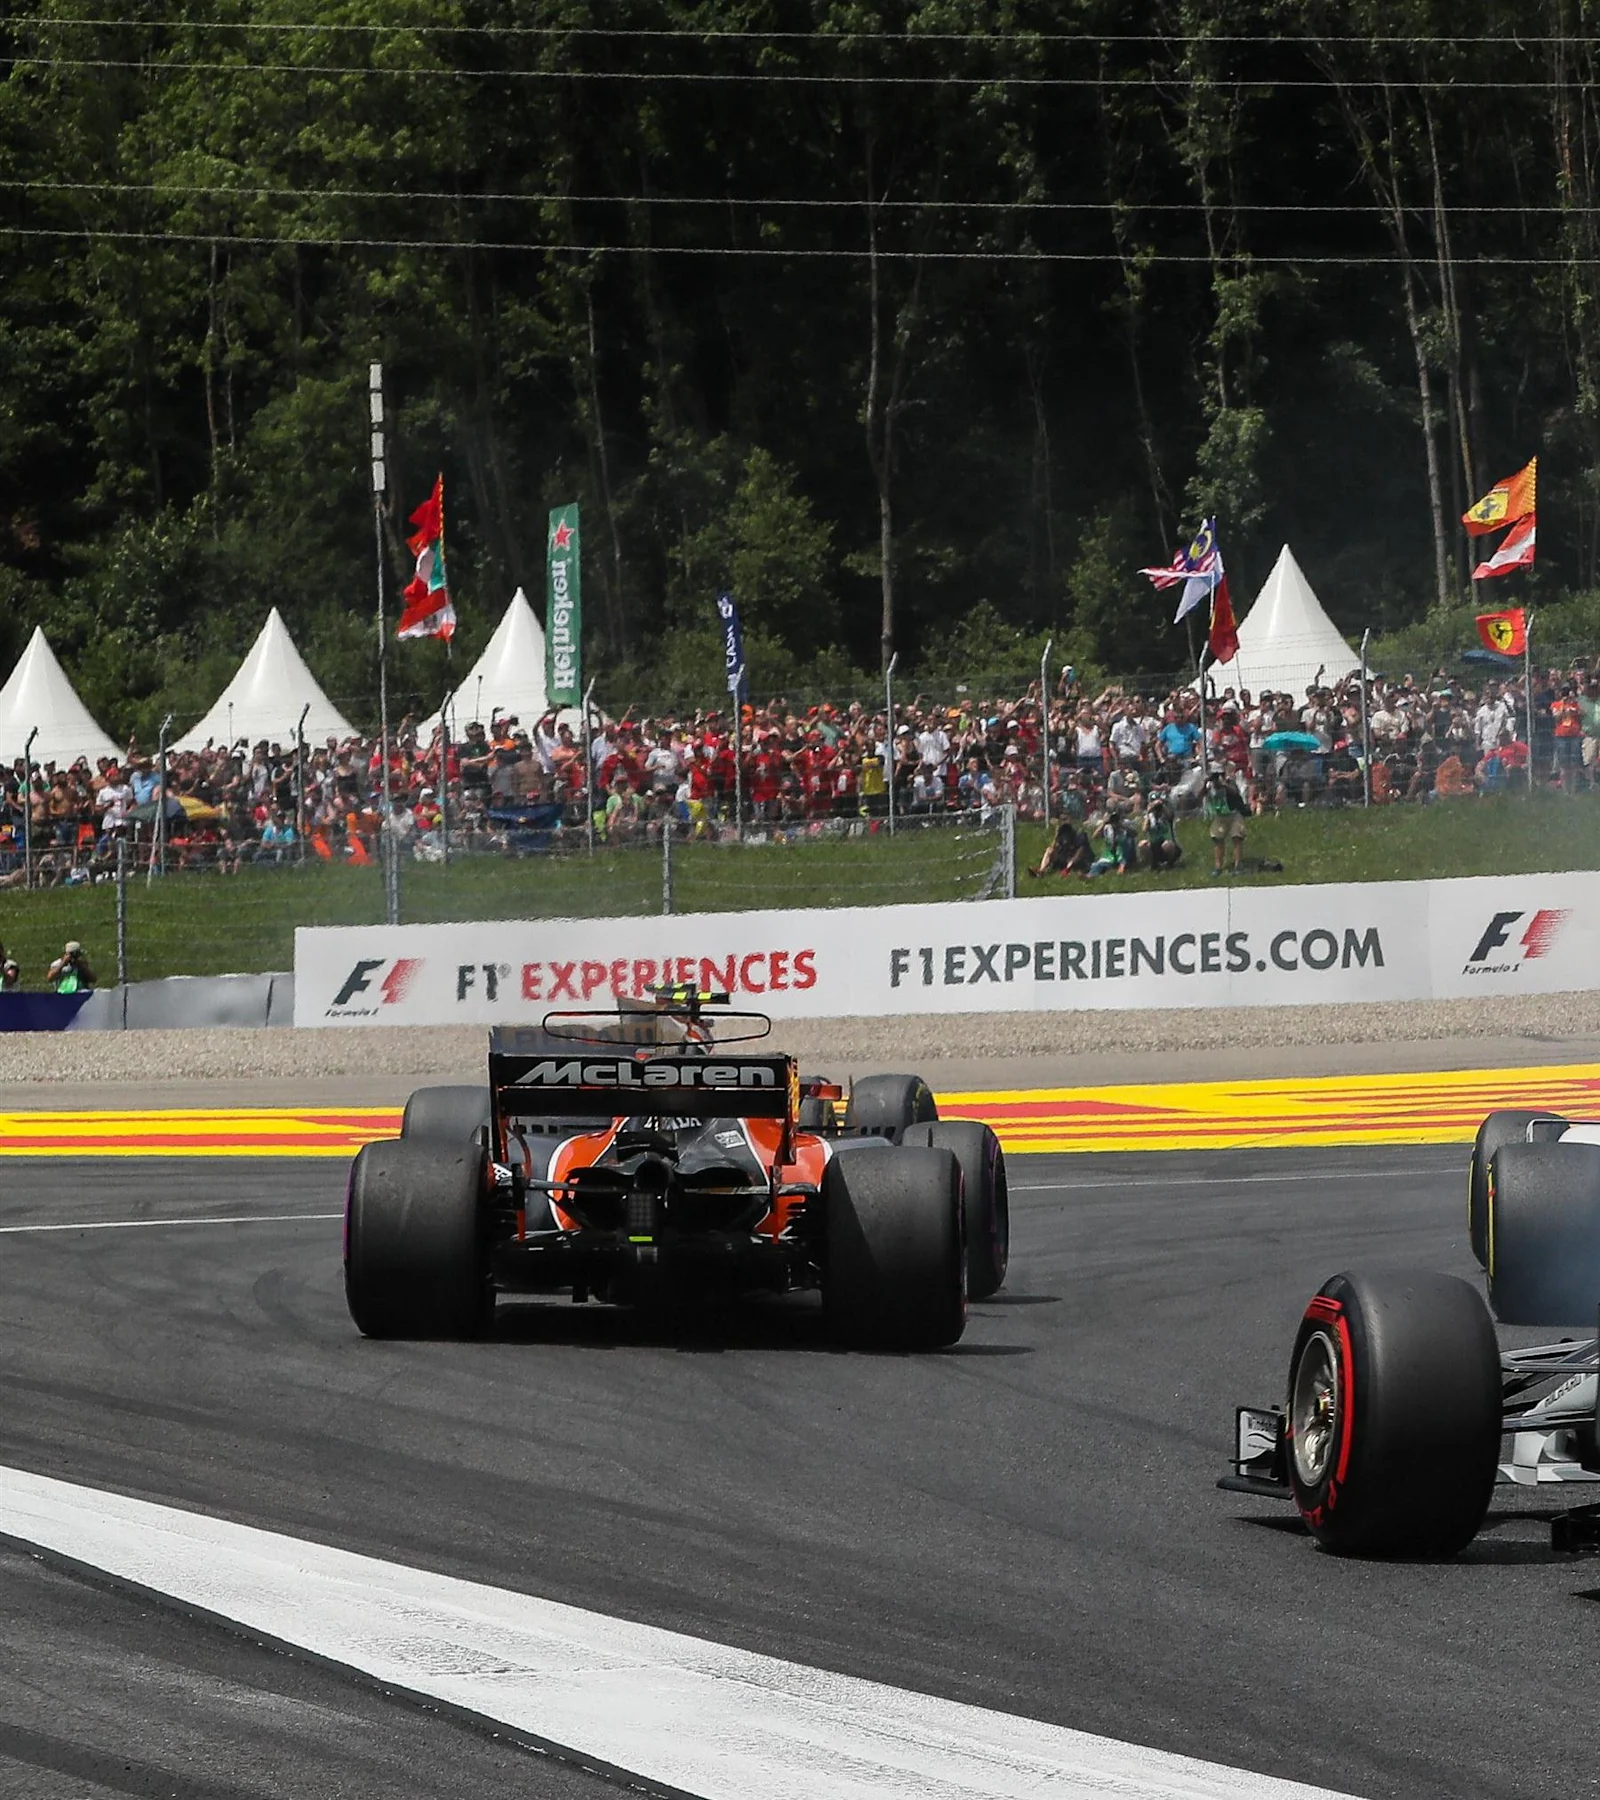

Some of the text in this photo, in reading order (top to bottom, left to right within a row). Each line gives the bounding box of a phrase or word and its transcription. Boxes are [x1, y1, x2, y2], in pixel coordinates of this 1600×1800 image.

[552, 560, 576, 689] Heineken
[521, 948, 818, 1001] EXPERIENCES
[889, 926, 1385, 988] F1EXPERIENCES.COM
[1461, 963, 1511, 975] Formula
[513, 1060, 775, 1087] McLaren
